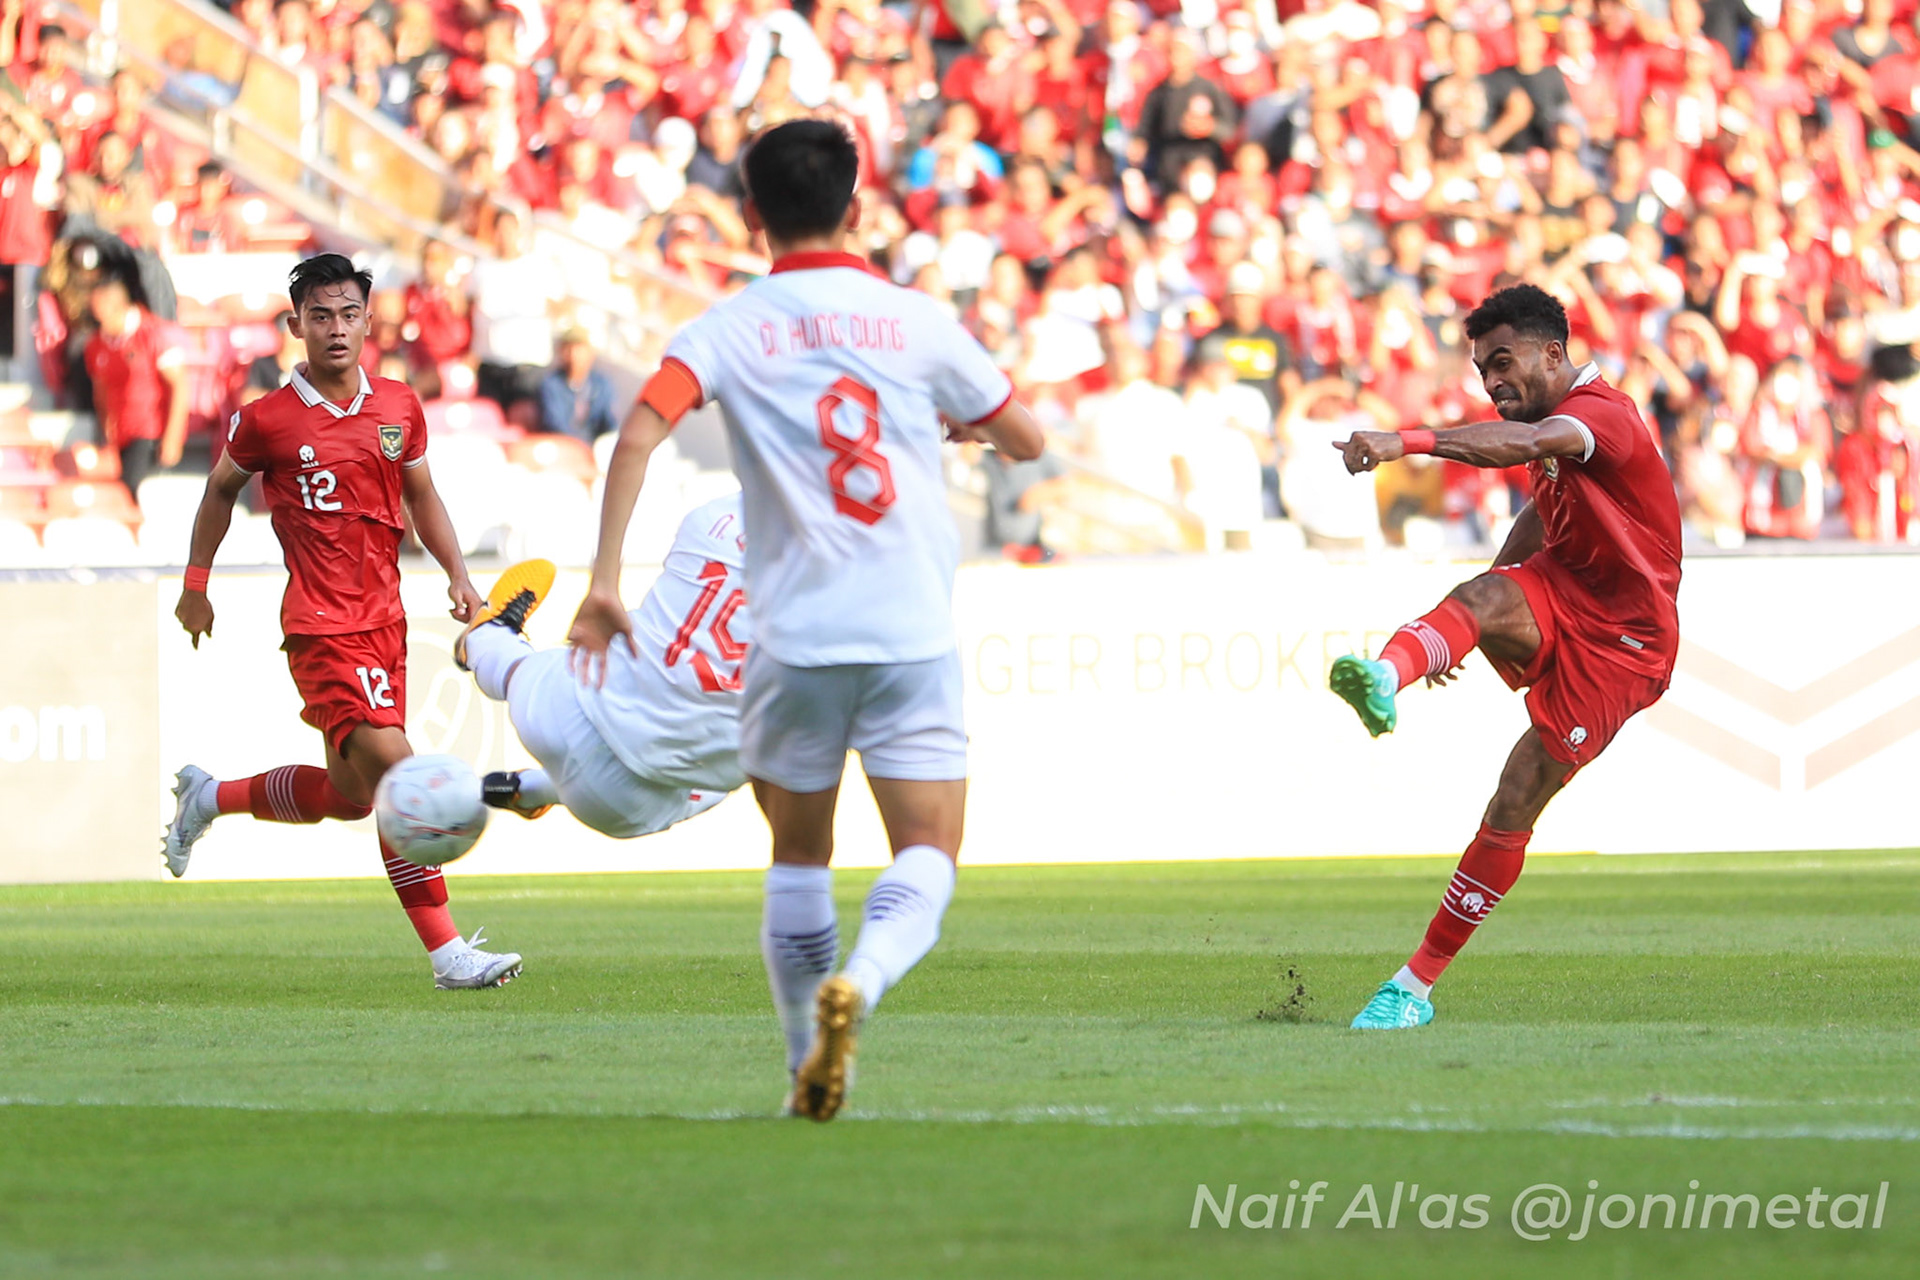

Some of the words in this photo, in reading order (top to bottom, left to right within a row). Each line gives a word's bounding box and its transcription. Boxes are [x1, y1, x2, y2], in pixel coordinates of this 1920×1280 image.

[817, 376, 896, 525] 8
[296, 470, 342, 511] 12
[356, 667, 396, 710] 12
